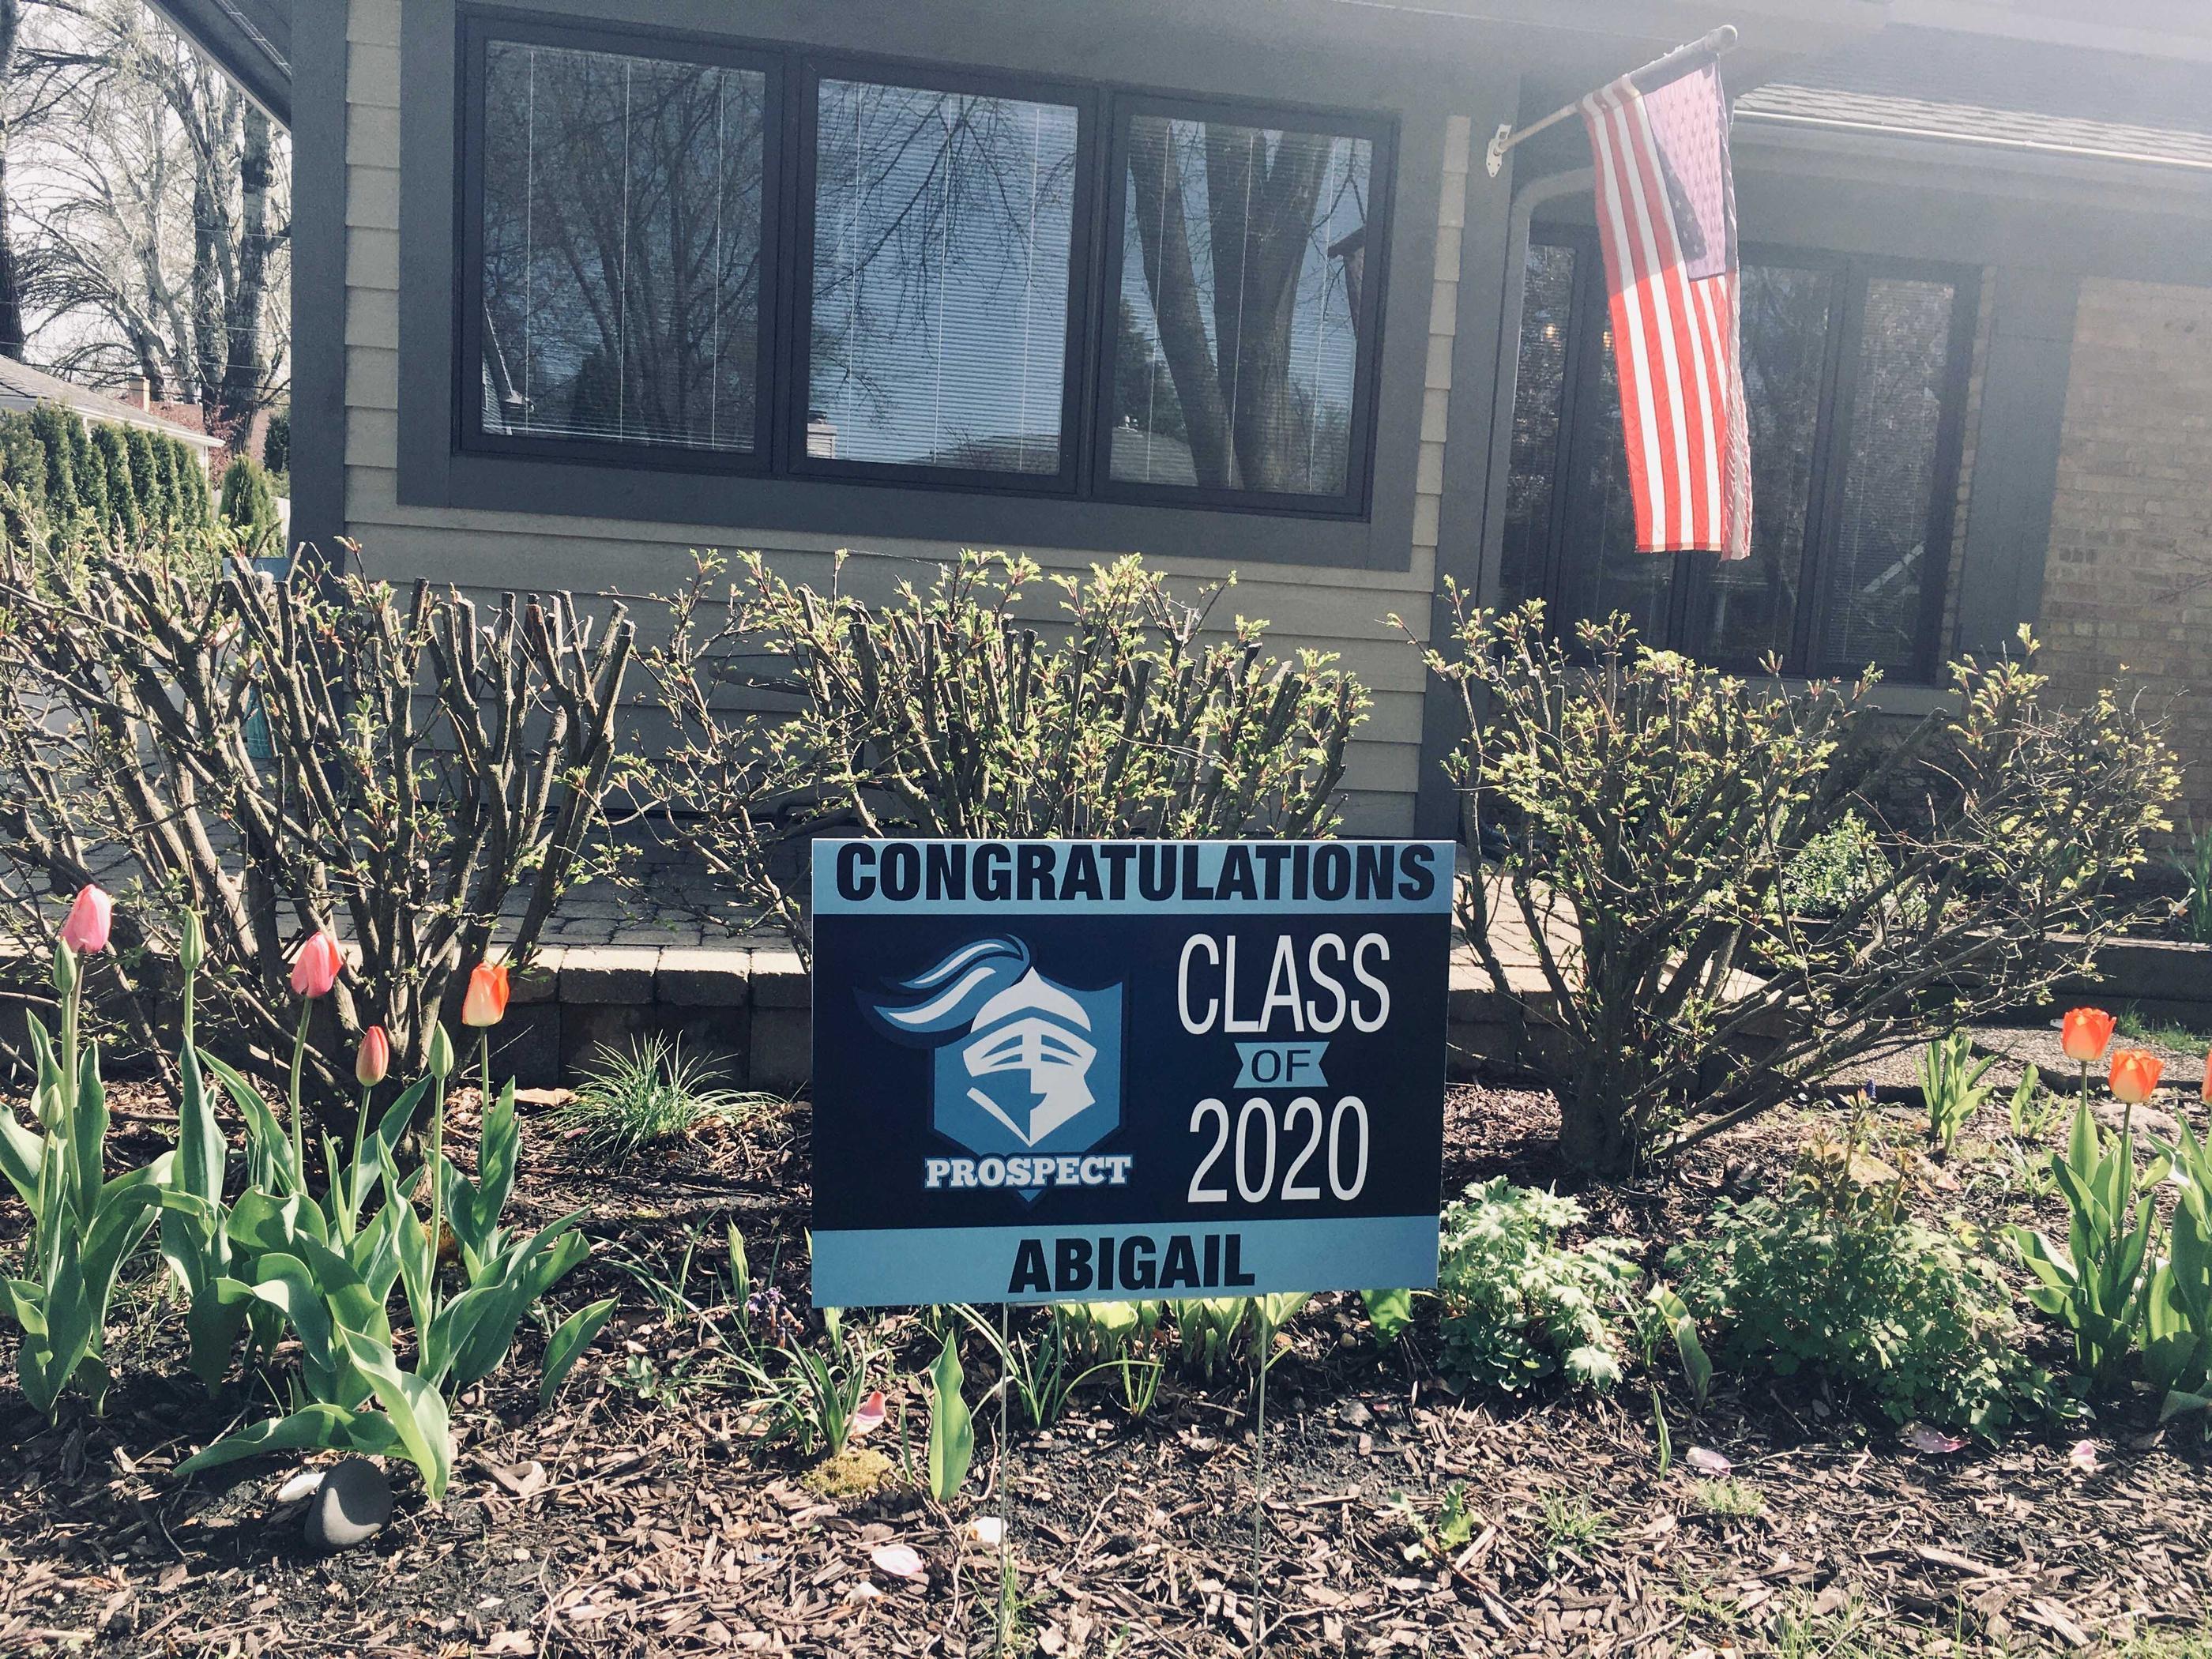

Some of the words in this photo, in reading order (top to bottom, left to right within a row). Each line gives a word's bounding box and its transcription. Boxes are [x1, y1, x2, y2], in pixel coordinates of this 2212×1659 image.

[836, 843, 1435, 902] CONGRATULATIONS
[1177, 933, 1390, 1035] CLASS
[1251, 1049, 1312, 1083] OF
[924, 1156, 1133, 1190] PROSPECT
[1187, 1097, 1370, 1203] 2020
[1008, 1234, 1255, 1294] ABIGAIL
